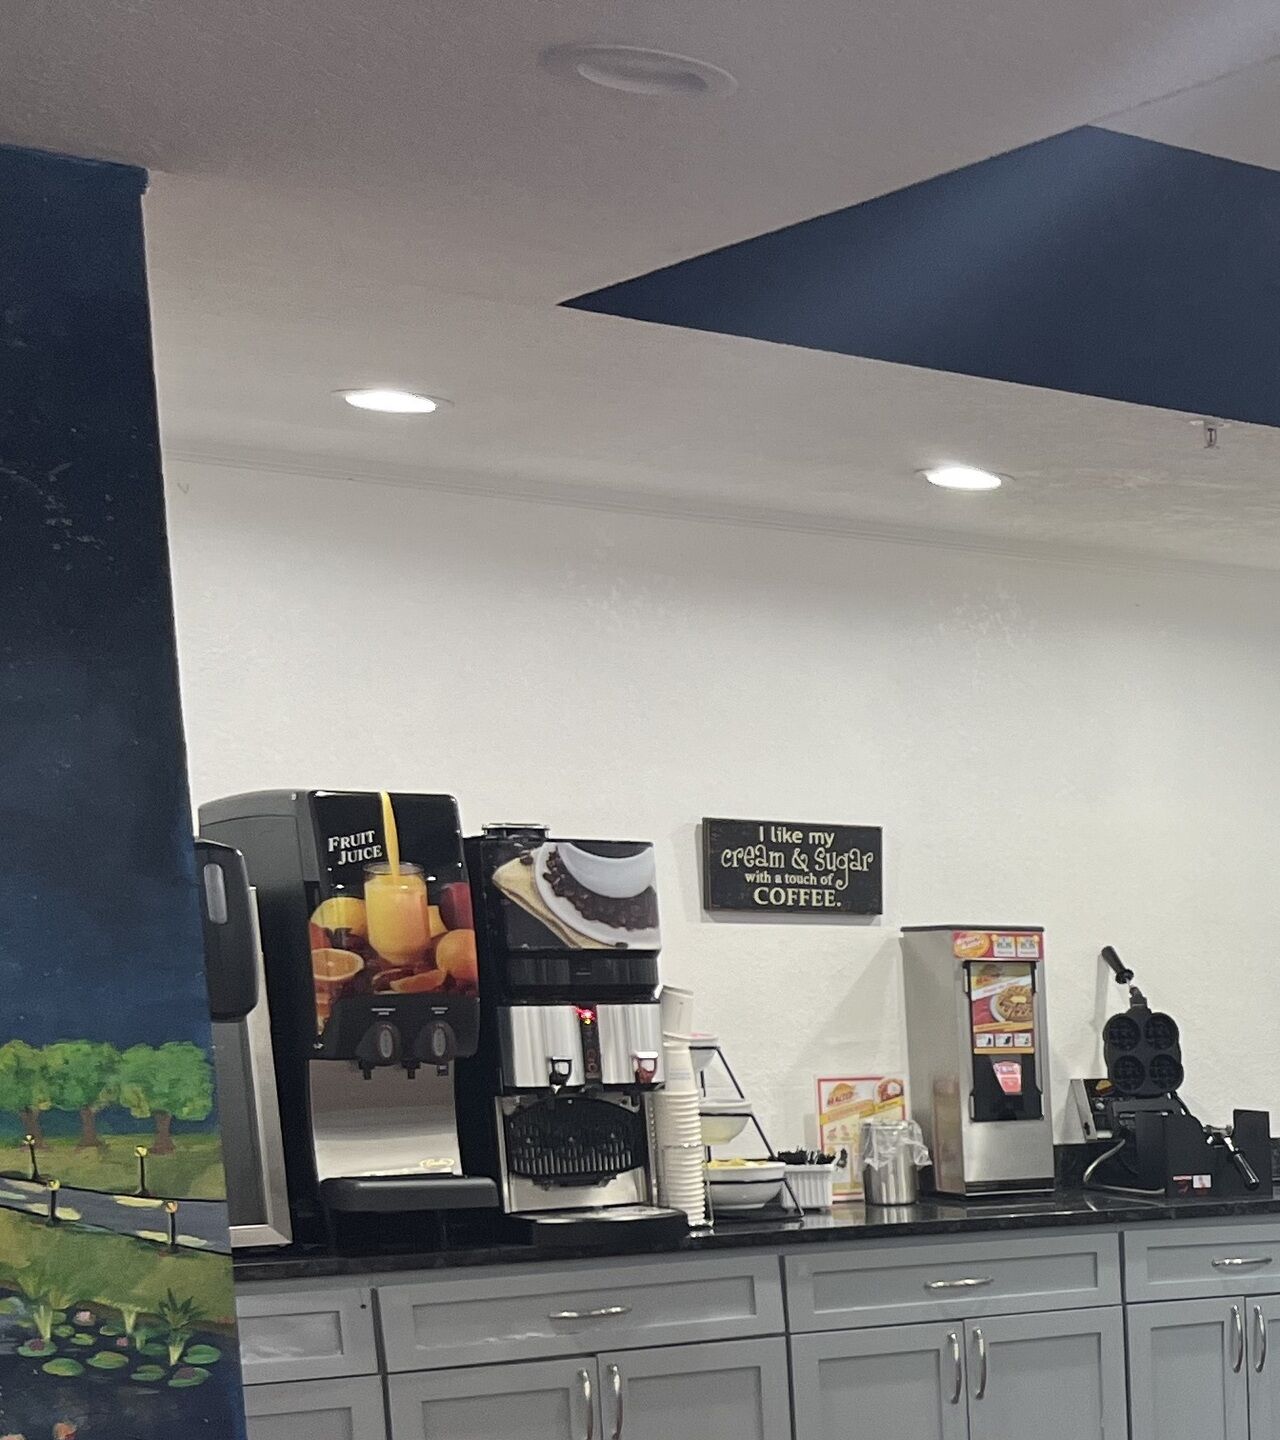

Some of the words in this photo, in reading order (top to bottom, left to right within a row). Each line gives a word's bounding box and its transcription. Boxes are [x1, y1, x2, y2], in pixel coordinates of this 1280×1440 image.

[328, 830, 376, 852] FRUIT
[759, 826, 764, 841] I
[771, 826, 803, 844] like
[809, 831, 835, 848] my
[337, 844, 383, 865] JUICE
[721, 845, 785, 868] cream
[791, 848, 809, 871] &
[745, 871, 771, 883] with
[774, 874, 782, 883] a
[785, 873, 817, 885] touch
[820, 873, 834, 885] of
[753, 887, 842, 907] COFFEE.
